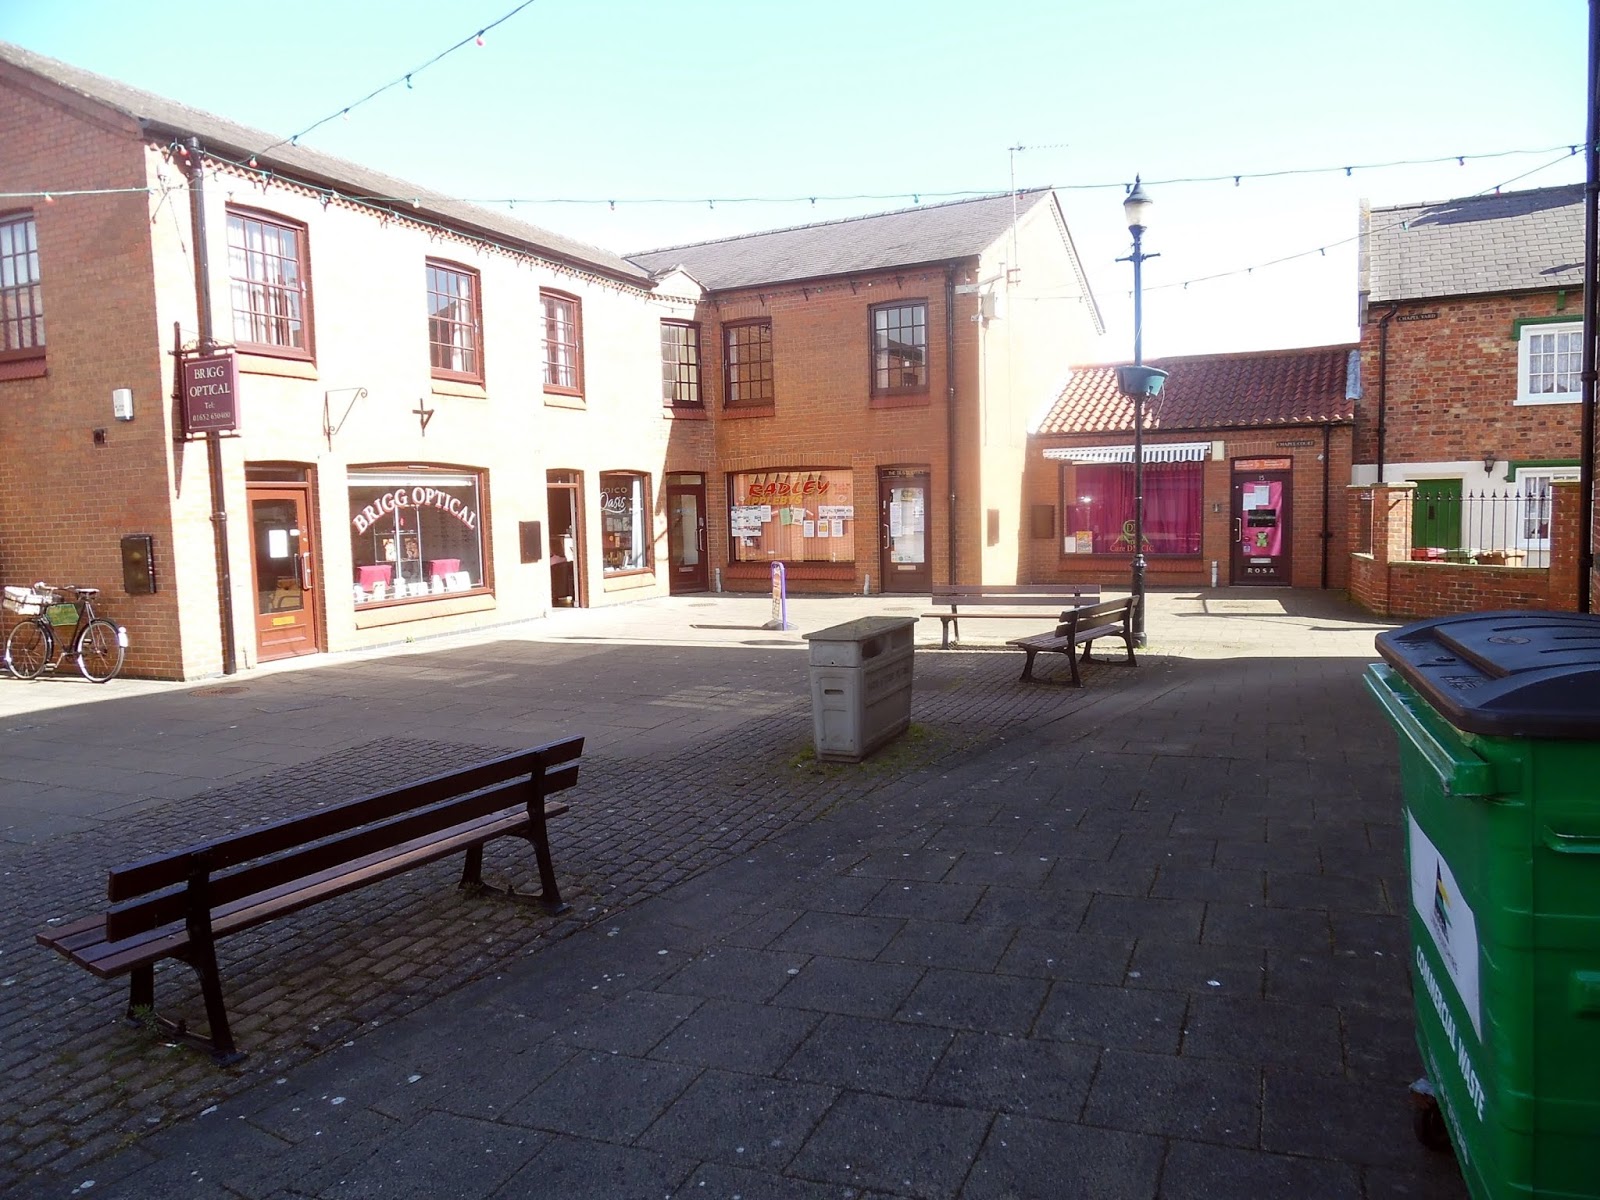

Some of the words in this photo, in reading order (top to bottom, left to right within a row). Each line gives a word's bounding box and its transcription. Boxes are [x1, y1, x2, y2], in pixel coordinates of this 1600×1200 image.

[194, 366, 225, 380] BRIGG
[189, 383, 230, 397] OPTICAL
[748, 480, 830, 497] RADLEY
[352, 488, 408, 535] BRIGG
[412, 486, 476, 530] OPTICAL
[600, 491, 626, 513] Oasis
[1415, 944, 1456, 1052] COMMERCIAL
[1458, 1036, 1485, 1123] WASTE
